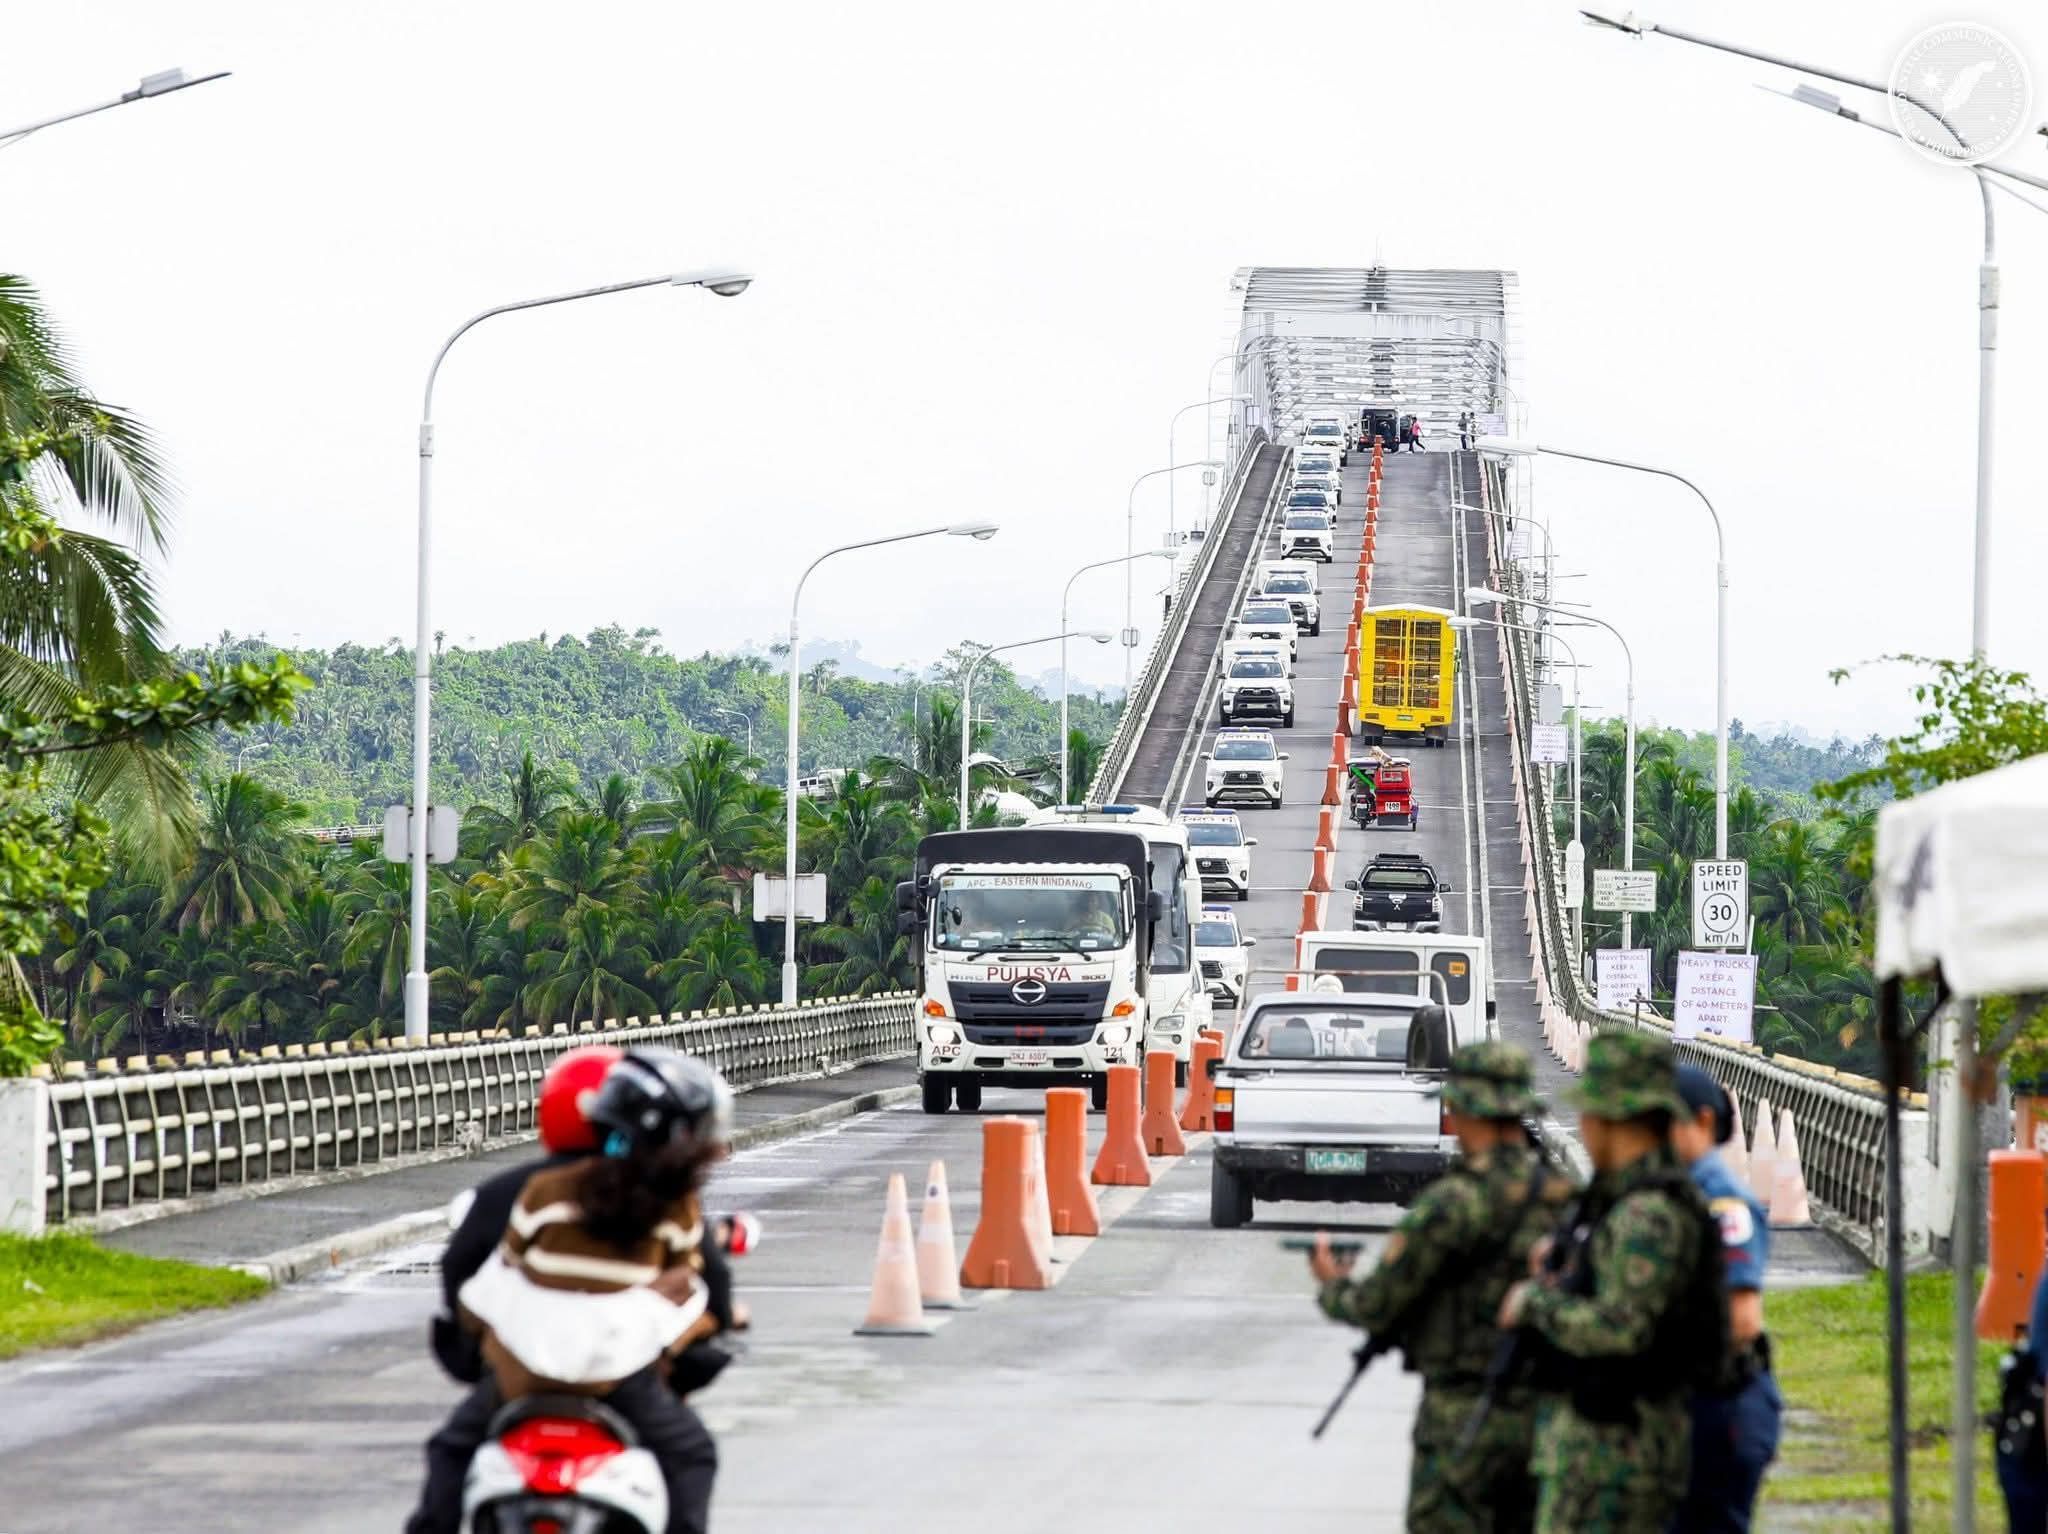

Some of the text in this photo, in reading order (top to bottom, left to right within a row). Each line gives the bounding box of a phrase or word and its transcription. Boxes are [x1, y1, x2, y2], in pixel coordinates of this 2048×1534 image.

[1698, 865, 1742, 877] SPEED
[966, 879, 986, 888] APC
[994, 876, 1039, 887] EASTERN
[1703, 880, 1738, 891] LIMIT
[1709, 904, 1732, 920] 30
[1704, 932, 1739, 944] km/h
[1680, 959, 1710, 968] HEAVY
[986, 966, 1072, 981] PULISYA
[1699, 973, 1735, 983] KEEP A
[1691, 986, 1737, 997] DISTANCE
[1681, 999, 1749, 1011] OF 40 METERS
[931, 1046, 961, 1056] APC
[1103, 1047, 1124, 1057] 121
